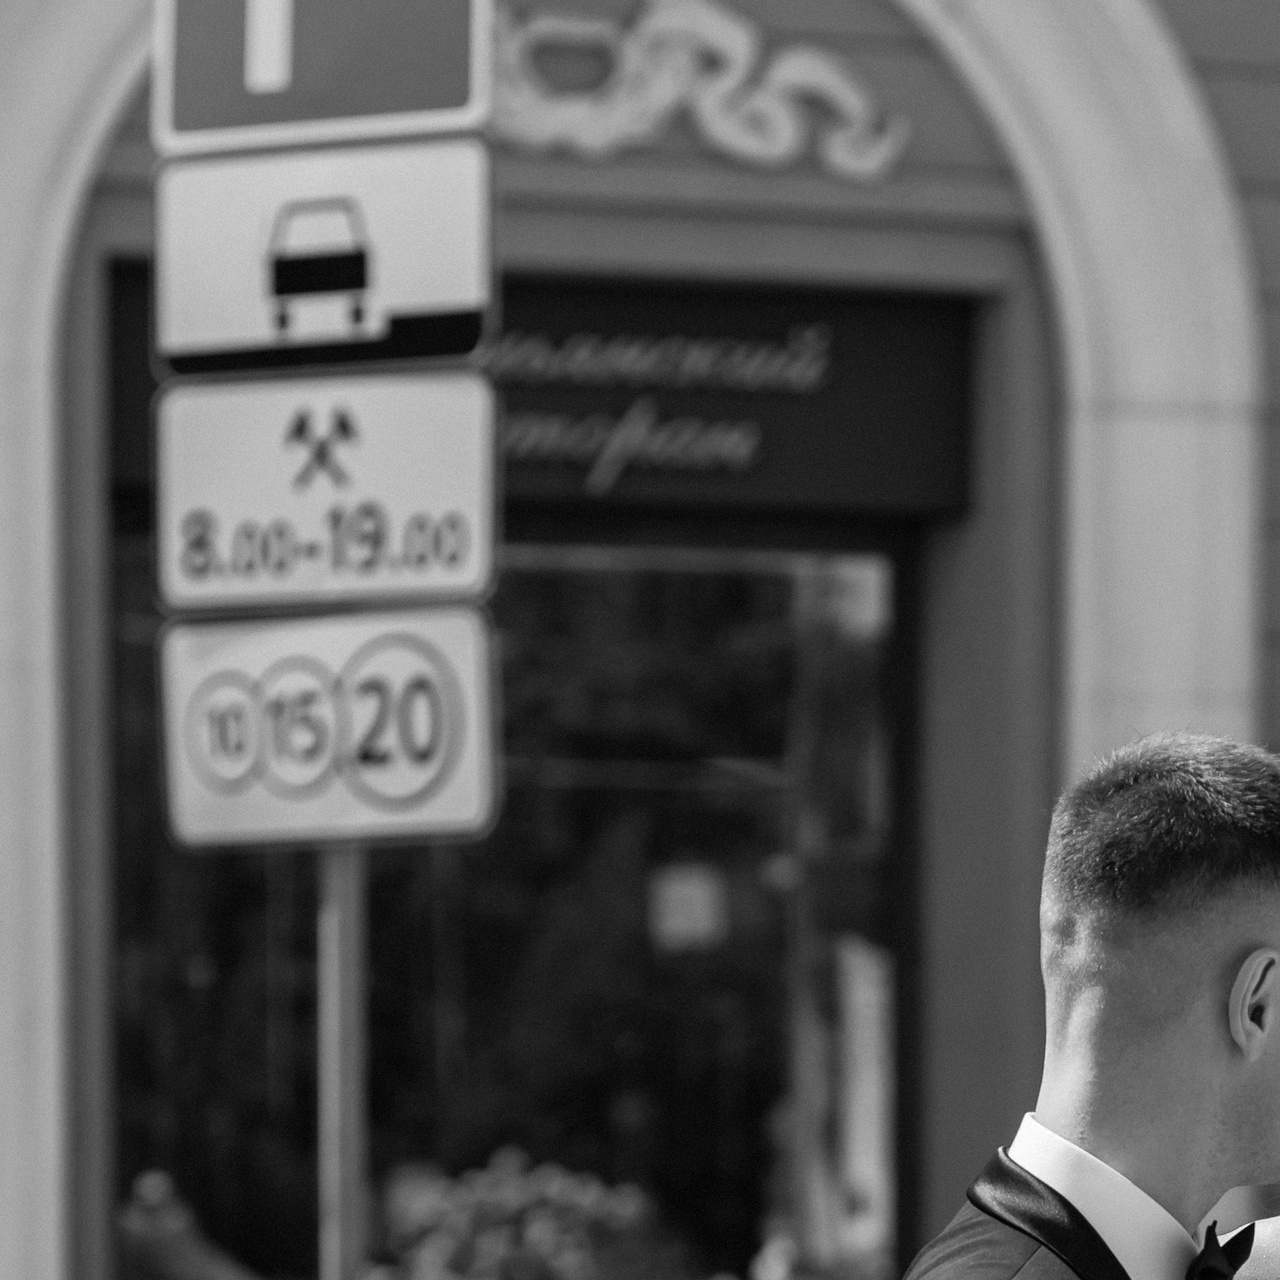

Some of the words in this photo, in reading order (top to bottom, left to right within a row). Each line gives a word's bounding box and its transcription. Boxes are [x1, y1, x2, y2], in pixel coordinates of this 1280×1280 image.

[504, 395, 762, 496] торан
[180, 501, 473, 581] 8.00-19.00
[207, 705, 245, 758] 10
[266, 690, 328, 763] 15
[356, 674, 441, 767] 20
